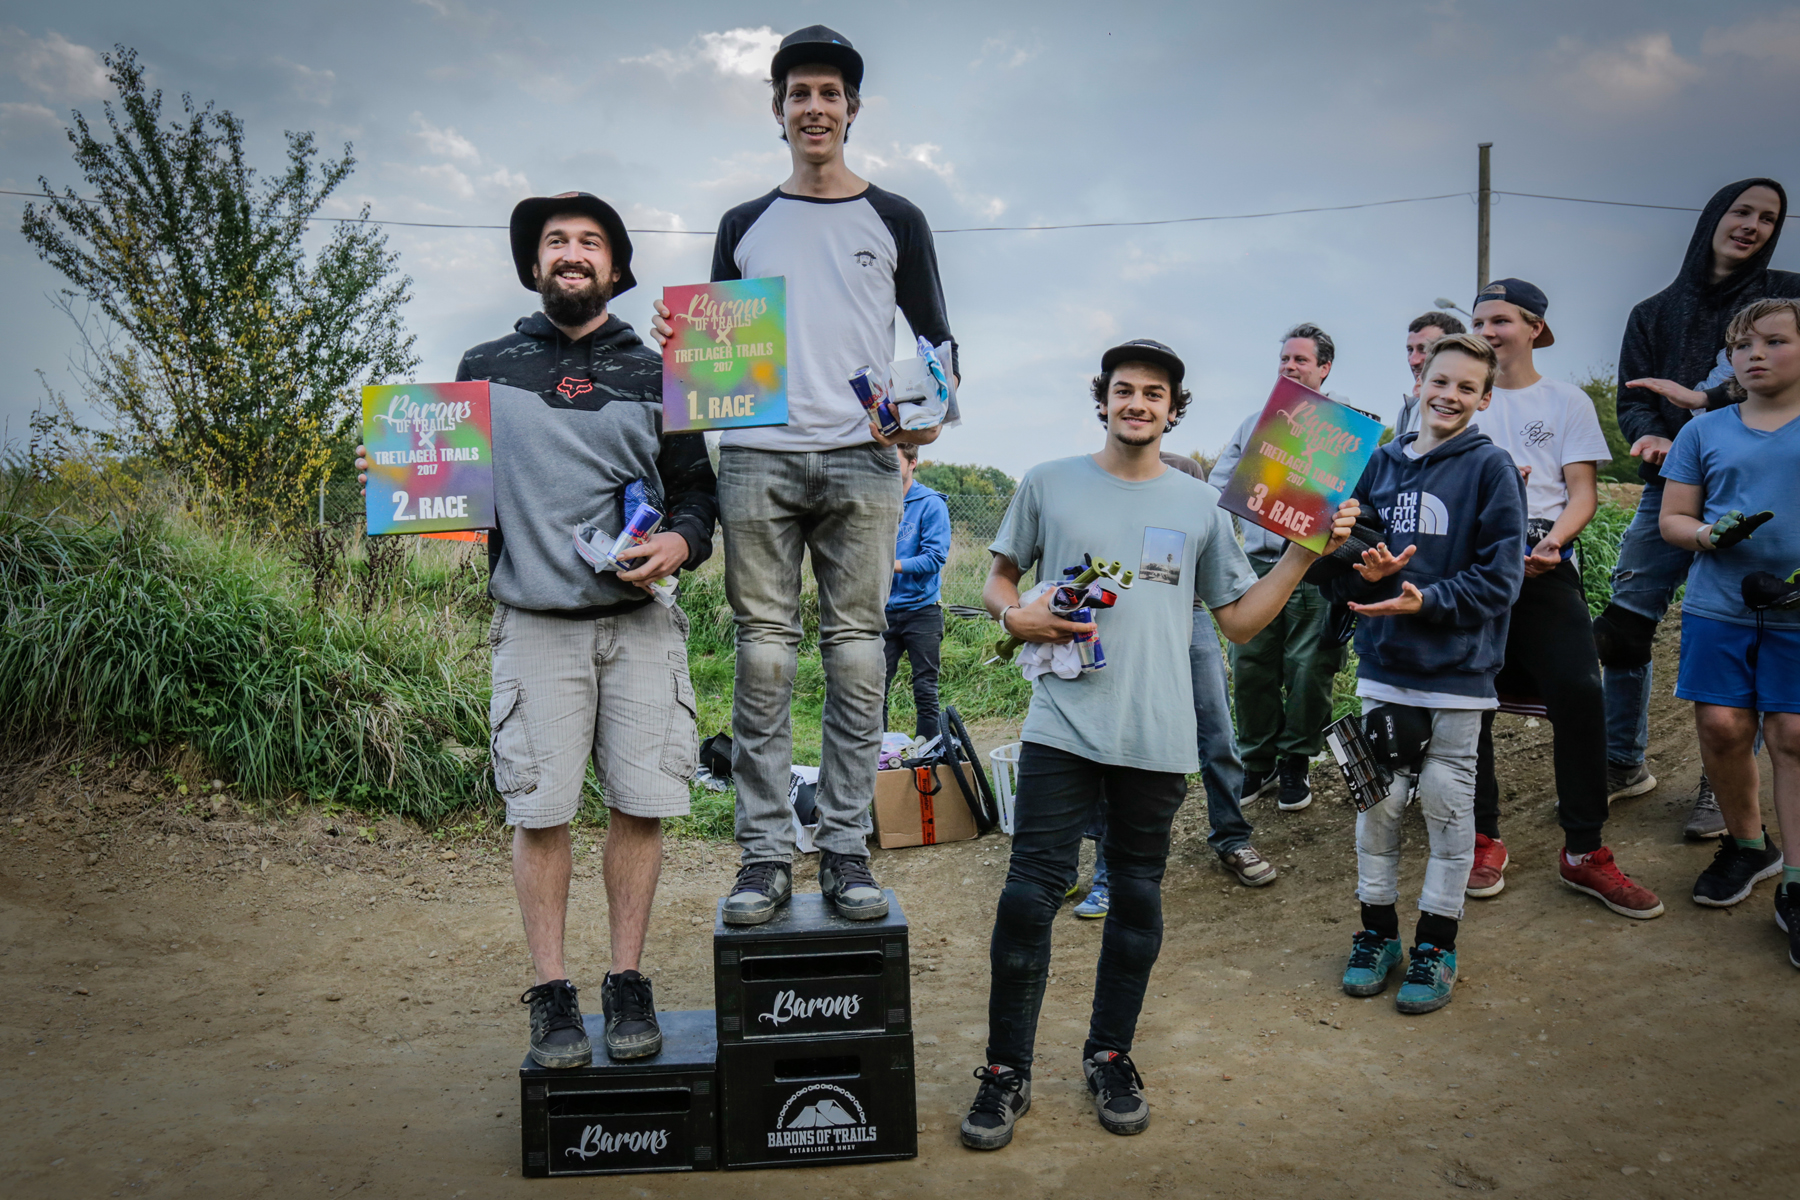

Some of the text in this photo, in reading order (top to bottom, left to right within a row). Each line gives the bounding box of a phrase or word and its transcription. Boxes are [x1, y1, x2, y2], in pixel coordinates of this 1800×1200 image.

[674, 293, 767, 325] Barons
[695, 314, 752, 331] OF TRAILS
[674, 342, 774, 363] TRETLAGER TRAILS
[713, 361, 733, 372] 2017
[373, 394, 477, 426] Barons
[687, 390, 755, 420] 1. RACE
[396, 417, 456, 433] OF TRAILS
[1277, 400, 1364, 454] Barons
[1290, 424, 1342, 457] OF TRAILS
[375, 447, 479, 465] TRETLAGER TRAILS
[417, 464, 438, 476] 2017
[1259, 441, 1346, 493] TRETLAGER TRAILS
[1286, 471, 1306, 487] 2017
[392, 490, 469, 522] 2. RACE
[1246, 483, 1315, 537] 3. RACE
[758, 989, 863, 1027] Barons
[565, 1124, 671, 1161] Barons
[767, 1126, 877, 1147] BARONS OF TRAILS
[790, 1146, 834, 1154] ESTABLISHED
